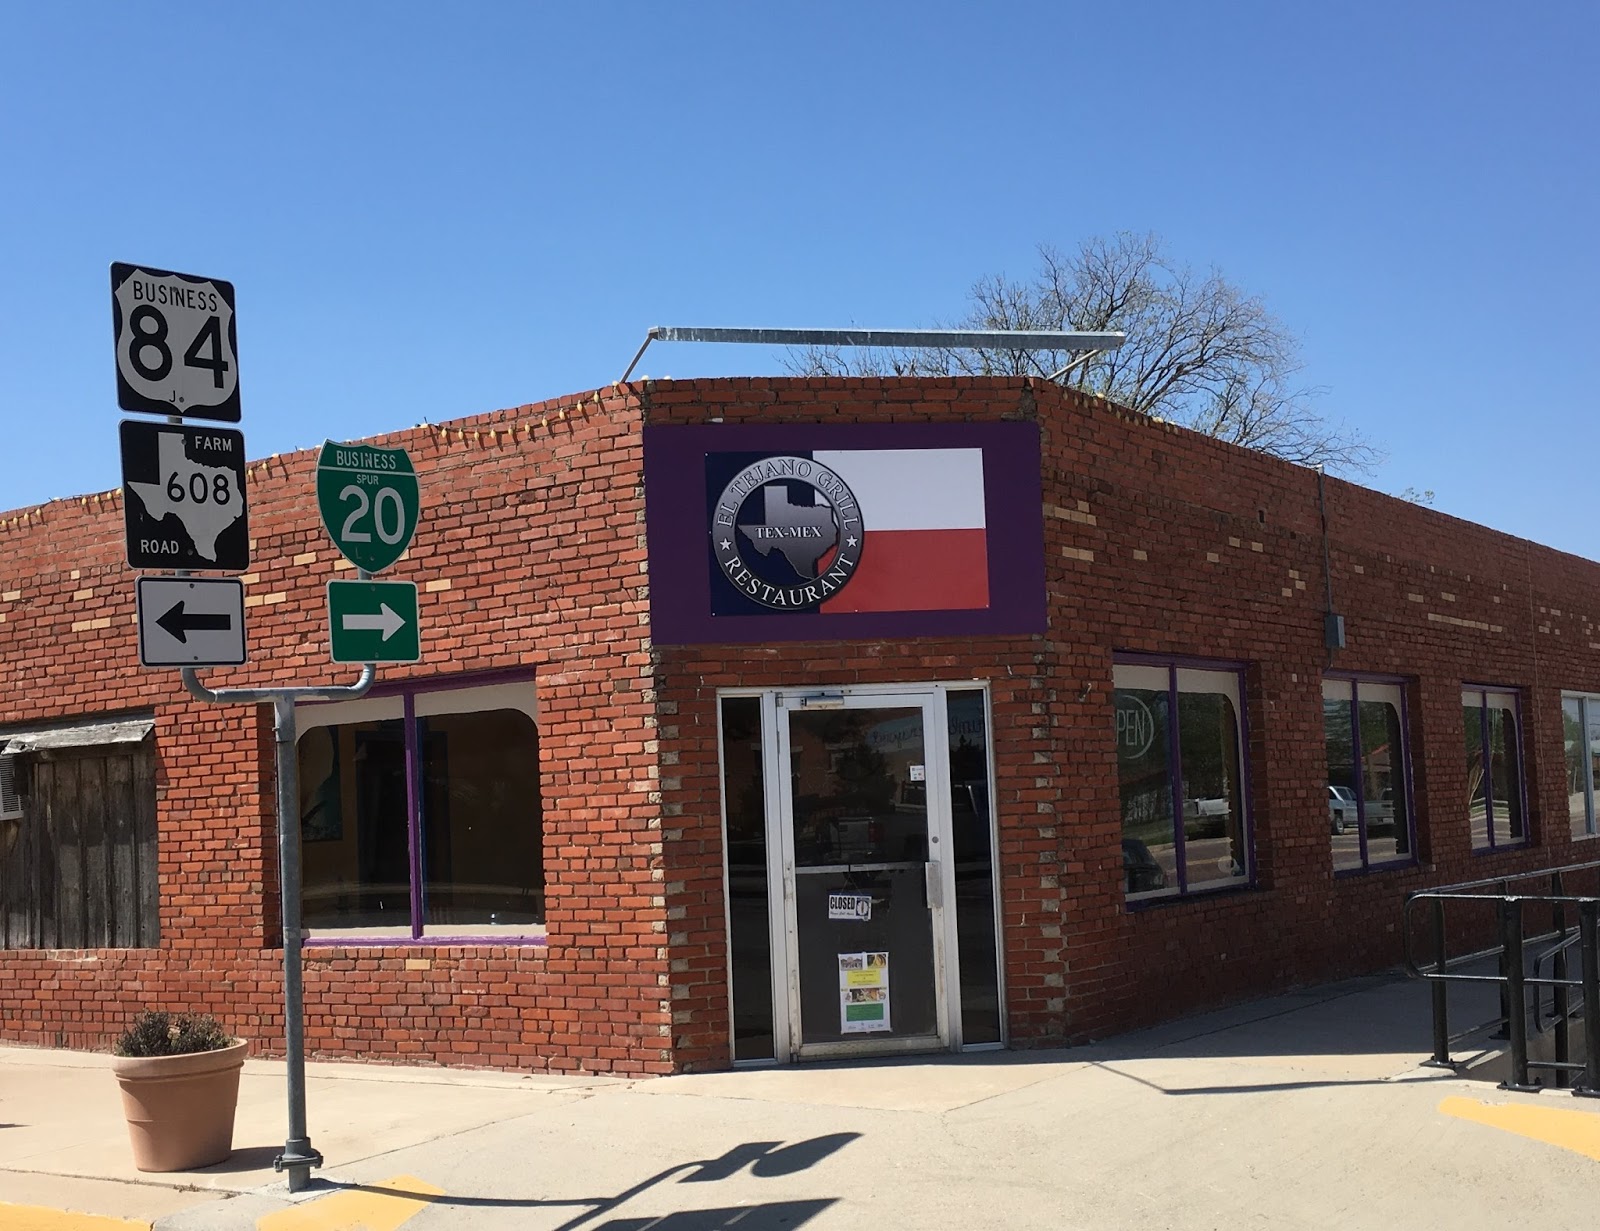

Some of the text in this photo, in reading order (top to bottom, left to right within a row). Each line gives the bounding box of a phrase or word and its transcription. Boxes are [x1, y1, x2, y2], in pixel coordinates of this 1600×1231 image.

[133, 280, 217, 312] BUSINESS
[129, 304, 228, 389] 84
[195, 435, 232, 452] FARM
[336, 450, 396, 470] BUSINESS
[167, 471, 231, 505] 608
[356, 473, 379, 485] SPUR
[717, 458, 860, 531] EL TEJANO GRILL
[339, 484, 406, 545] 20
[140, 539, 179, 555] ROAD
[755, 526, 822, 539] TEX-MEX
[724, 553, 854, 606] RESTAURANT
[1115, 709, 1145, 747] PEN
[830, 896, 855, 910] CLOSED
